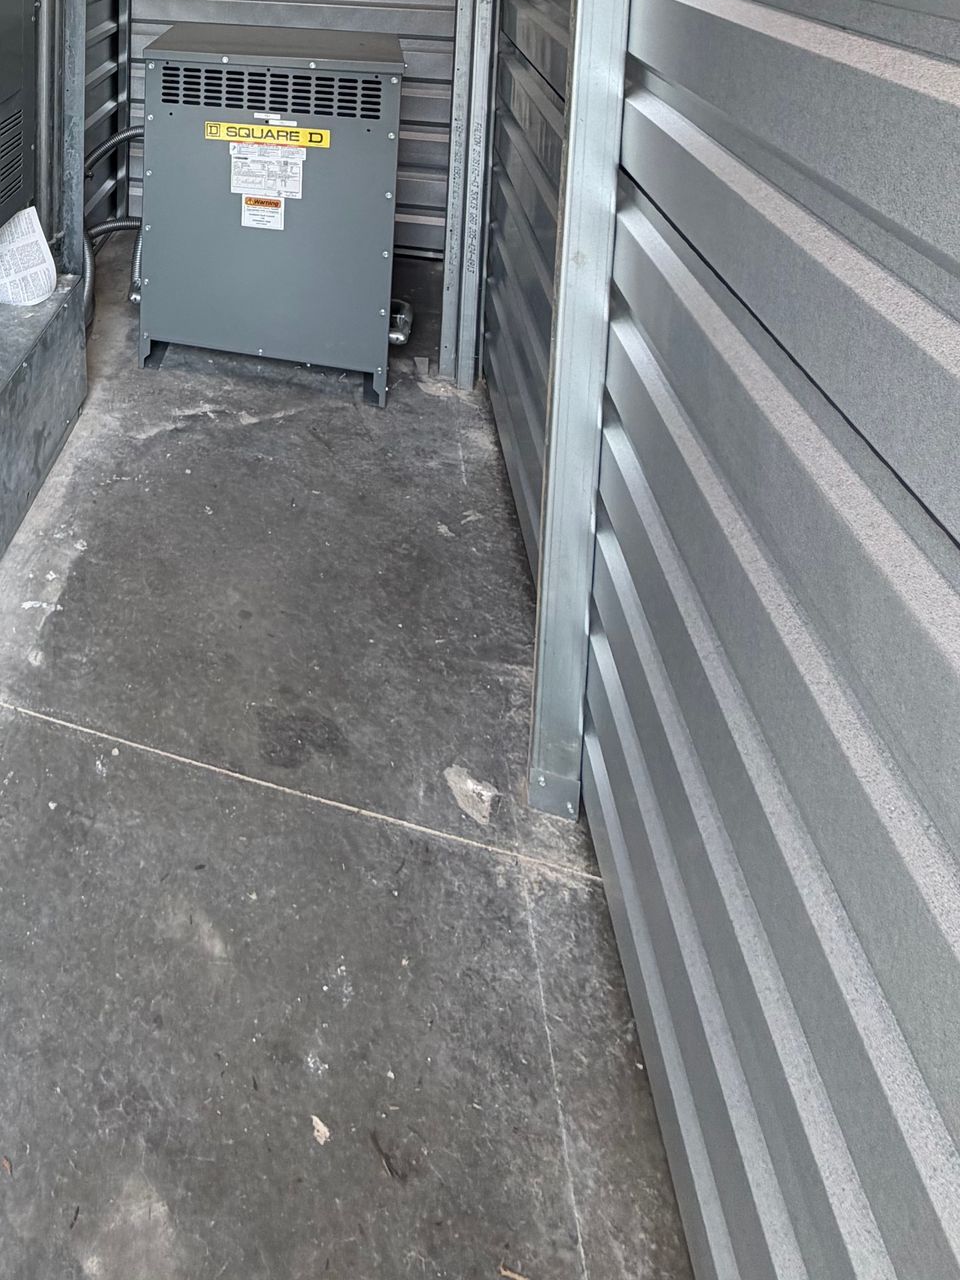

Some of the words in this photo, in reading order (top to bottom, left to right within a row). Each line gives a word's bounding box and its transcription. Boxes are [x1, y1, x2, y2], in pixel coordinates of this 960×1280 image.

[226, 126, 300, 143] SQUARE
[307, 131, 324, 144] D
[253, 199, 280, 208] Warning
